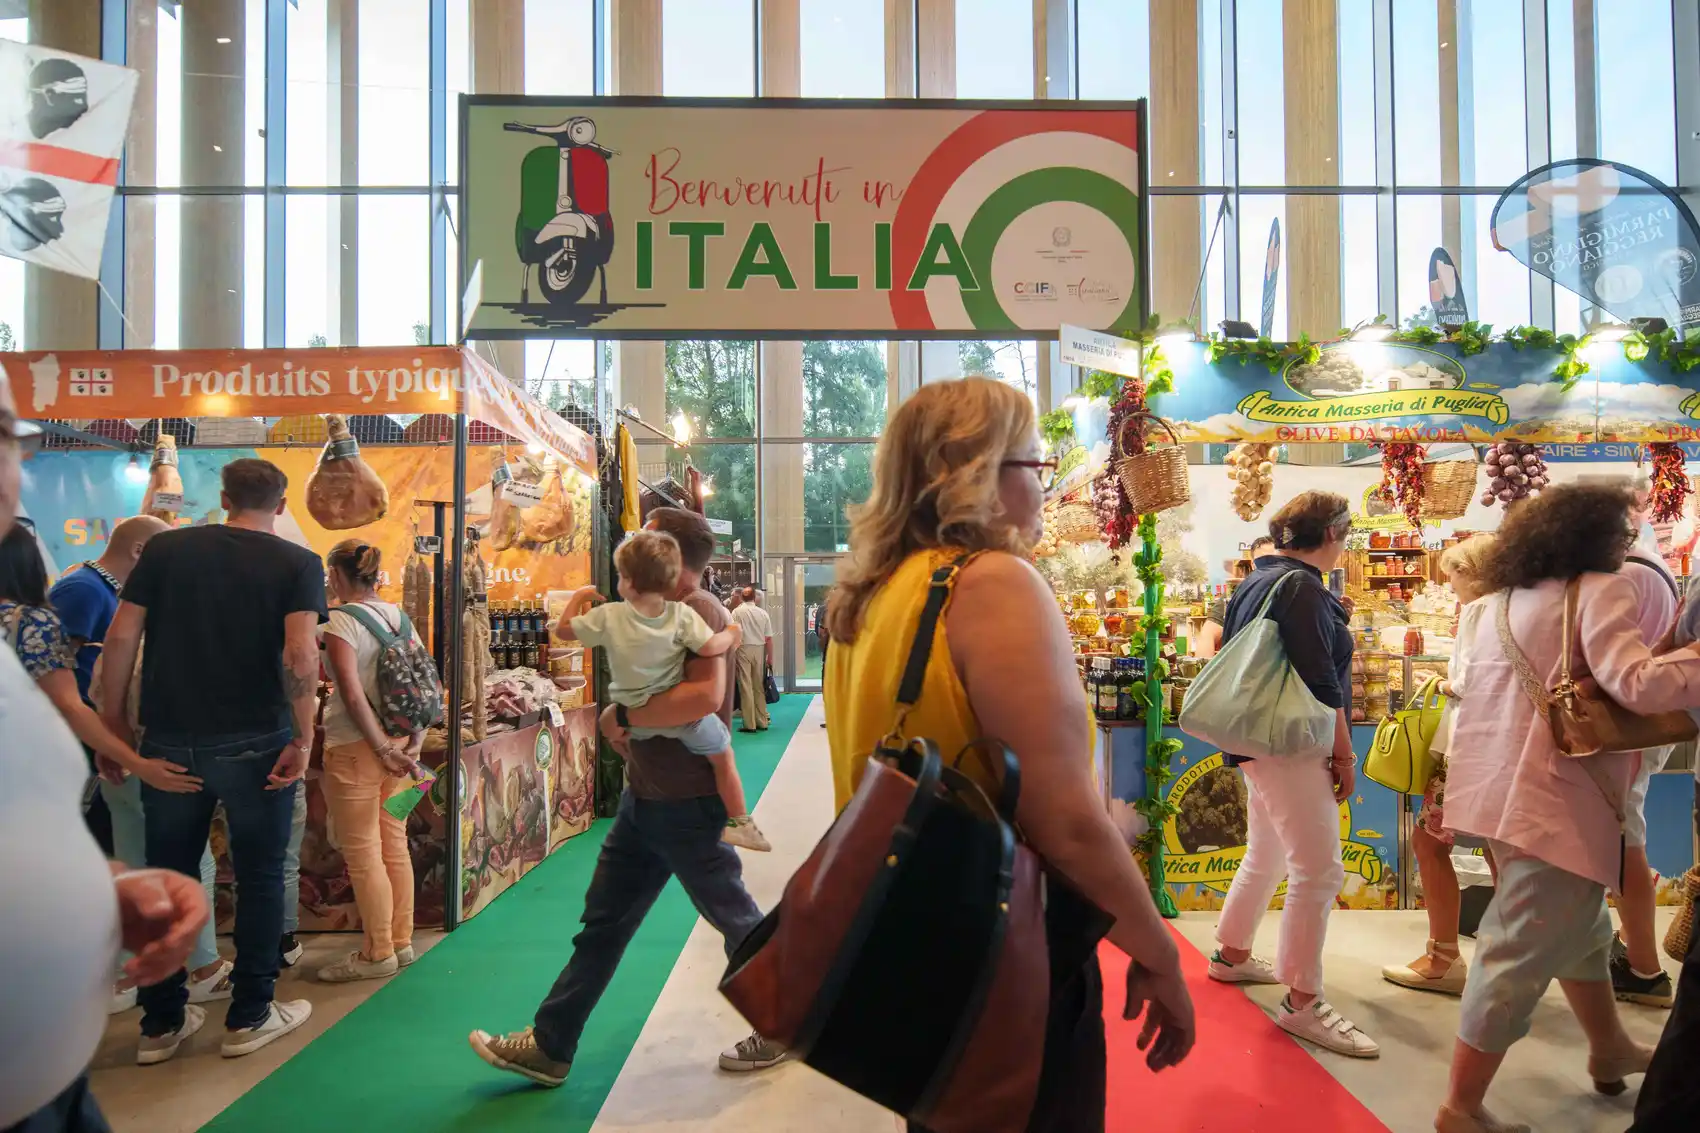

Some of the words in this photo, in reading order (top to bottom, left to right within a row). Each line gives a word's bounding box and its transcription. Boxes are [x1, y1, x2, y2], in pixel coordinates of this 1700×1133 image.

[645, 148, 853, 221] Benvenuti
[863, 176, 904, 209] in
[635, 220, 980, 292] ITALIA
[152, 362, 331, 398] Produits
[1259, 402, 1318, 418] Antica
[1324, 399, 1402, 417] Masseria
[1409, 397, 1426, 410] di
[1432, 396, 1486, 412] Puglia
[1276, 426, 1340, 442] OLIVE
[1350, 426, 1377, 441] DA
[1388, 426, 1469, 442] TAVOLA
